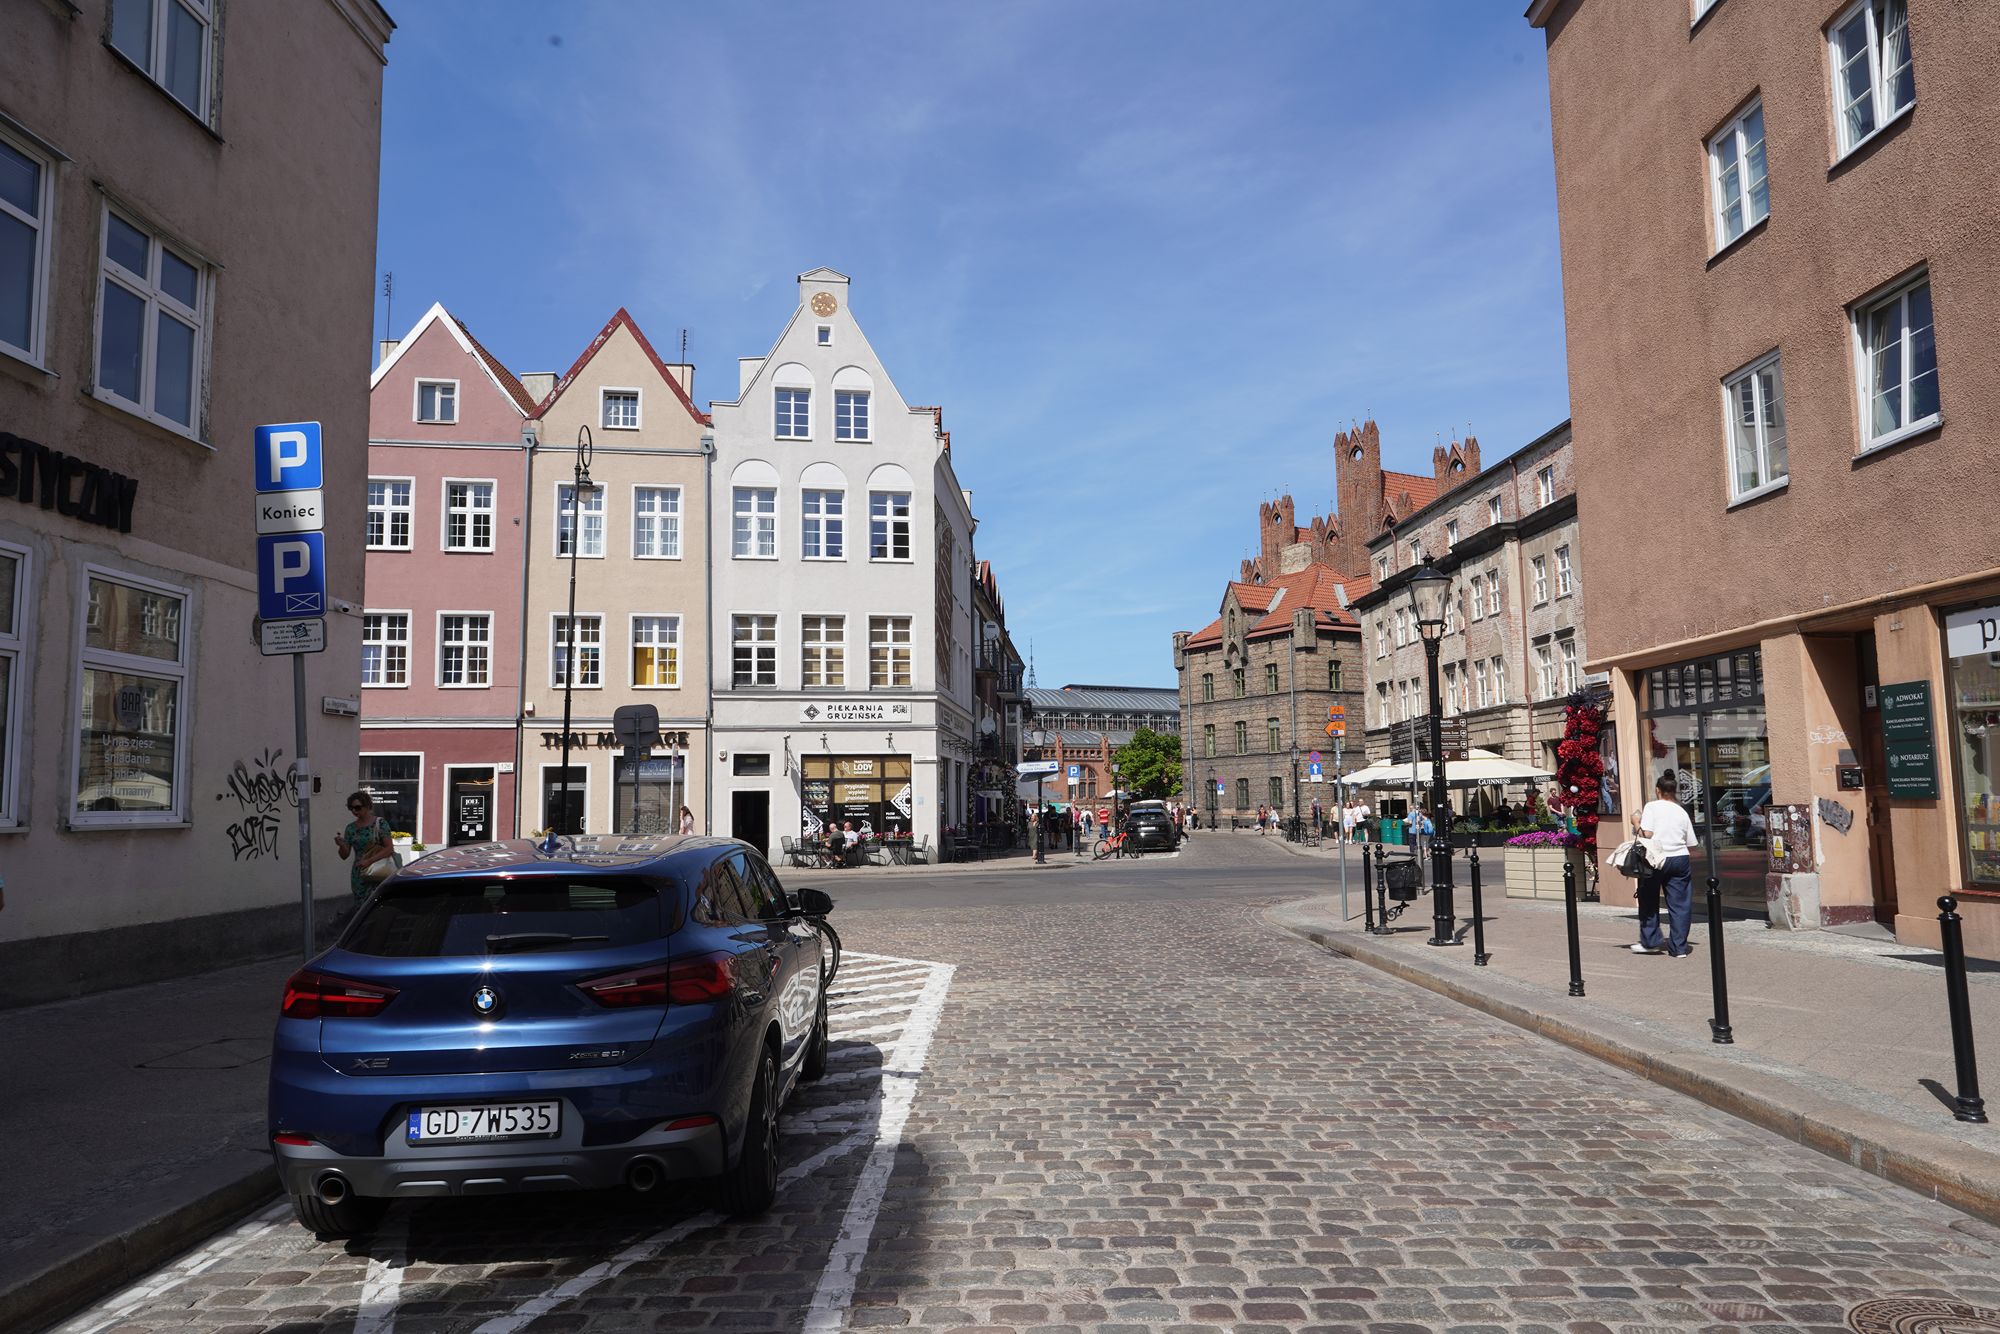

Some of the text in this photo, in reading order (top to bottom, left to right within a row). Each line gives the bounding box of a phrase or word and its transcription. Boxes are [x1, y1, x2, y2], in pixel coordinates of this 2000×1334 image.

[269, 430, 308, 483] P
[262, 505, 316, 521] Koniec
[273, 540, 311, 594] P
[1976, 617, 2000, 651] p
[121, 691, 140, 711] BAR
[1896, 693, 1924, 702] ADWOKAT
[1900, 753, 1930, 761] NOTARIUSZ
[854, 763, 873, 771] LODY
[1478, 777, 1511, 785] GUINNESS
[427, 1105, 551, 1136] GD 7W535
[410, 1127, 420, 1135] PL
